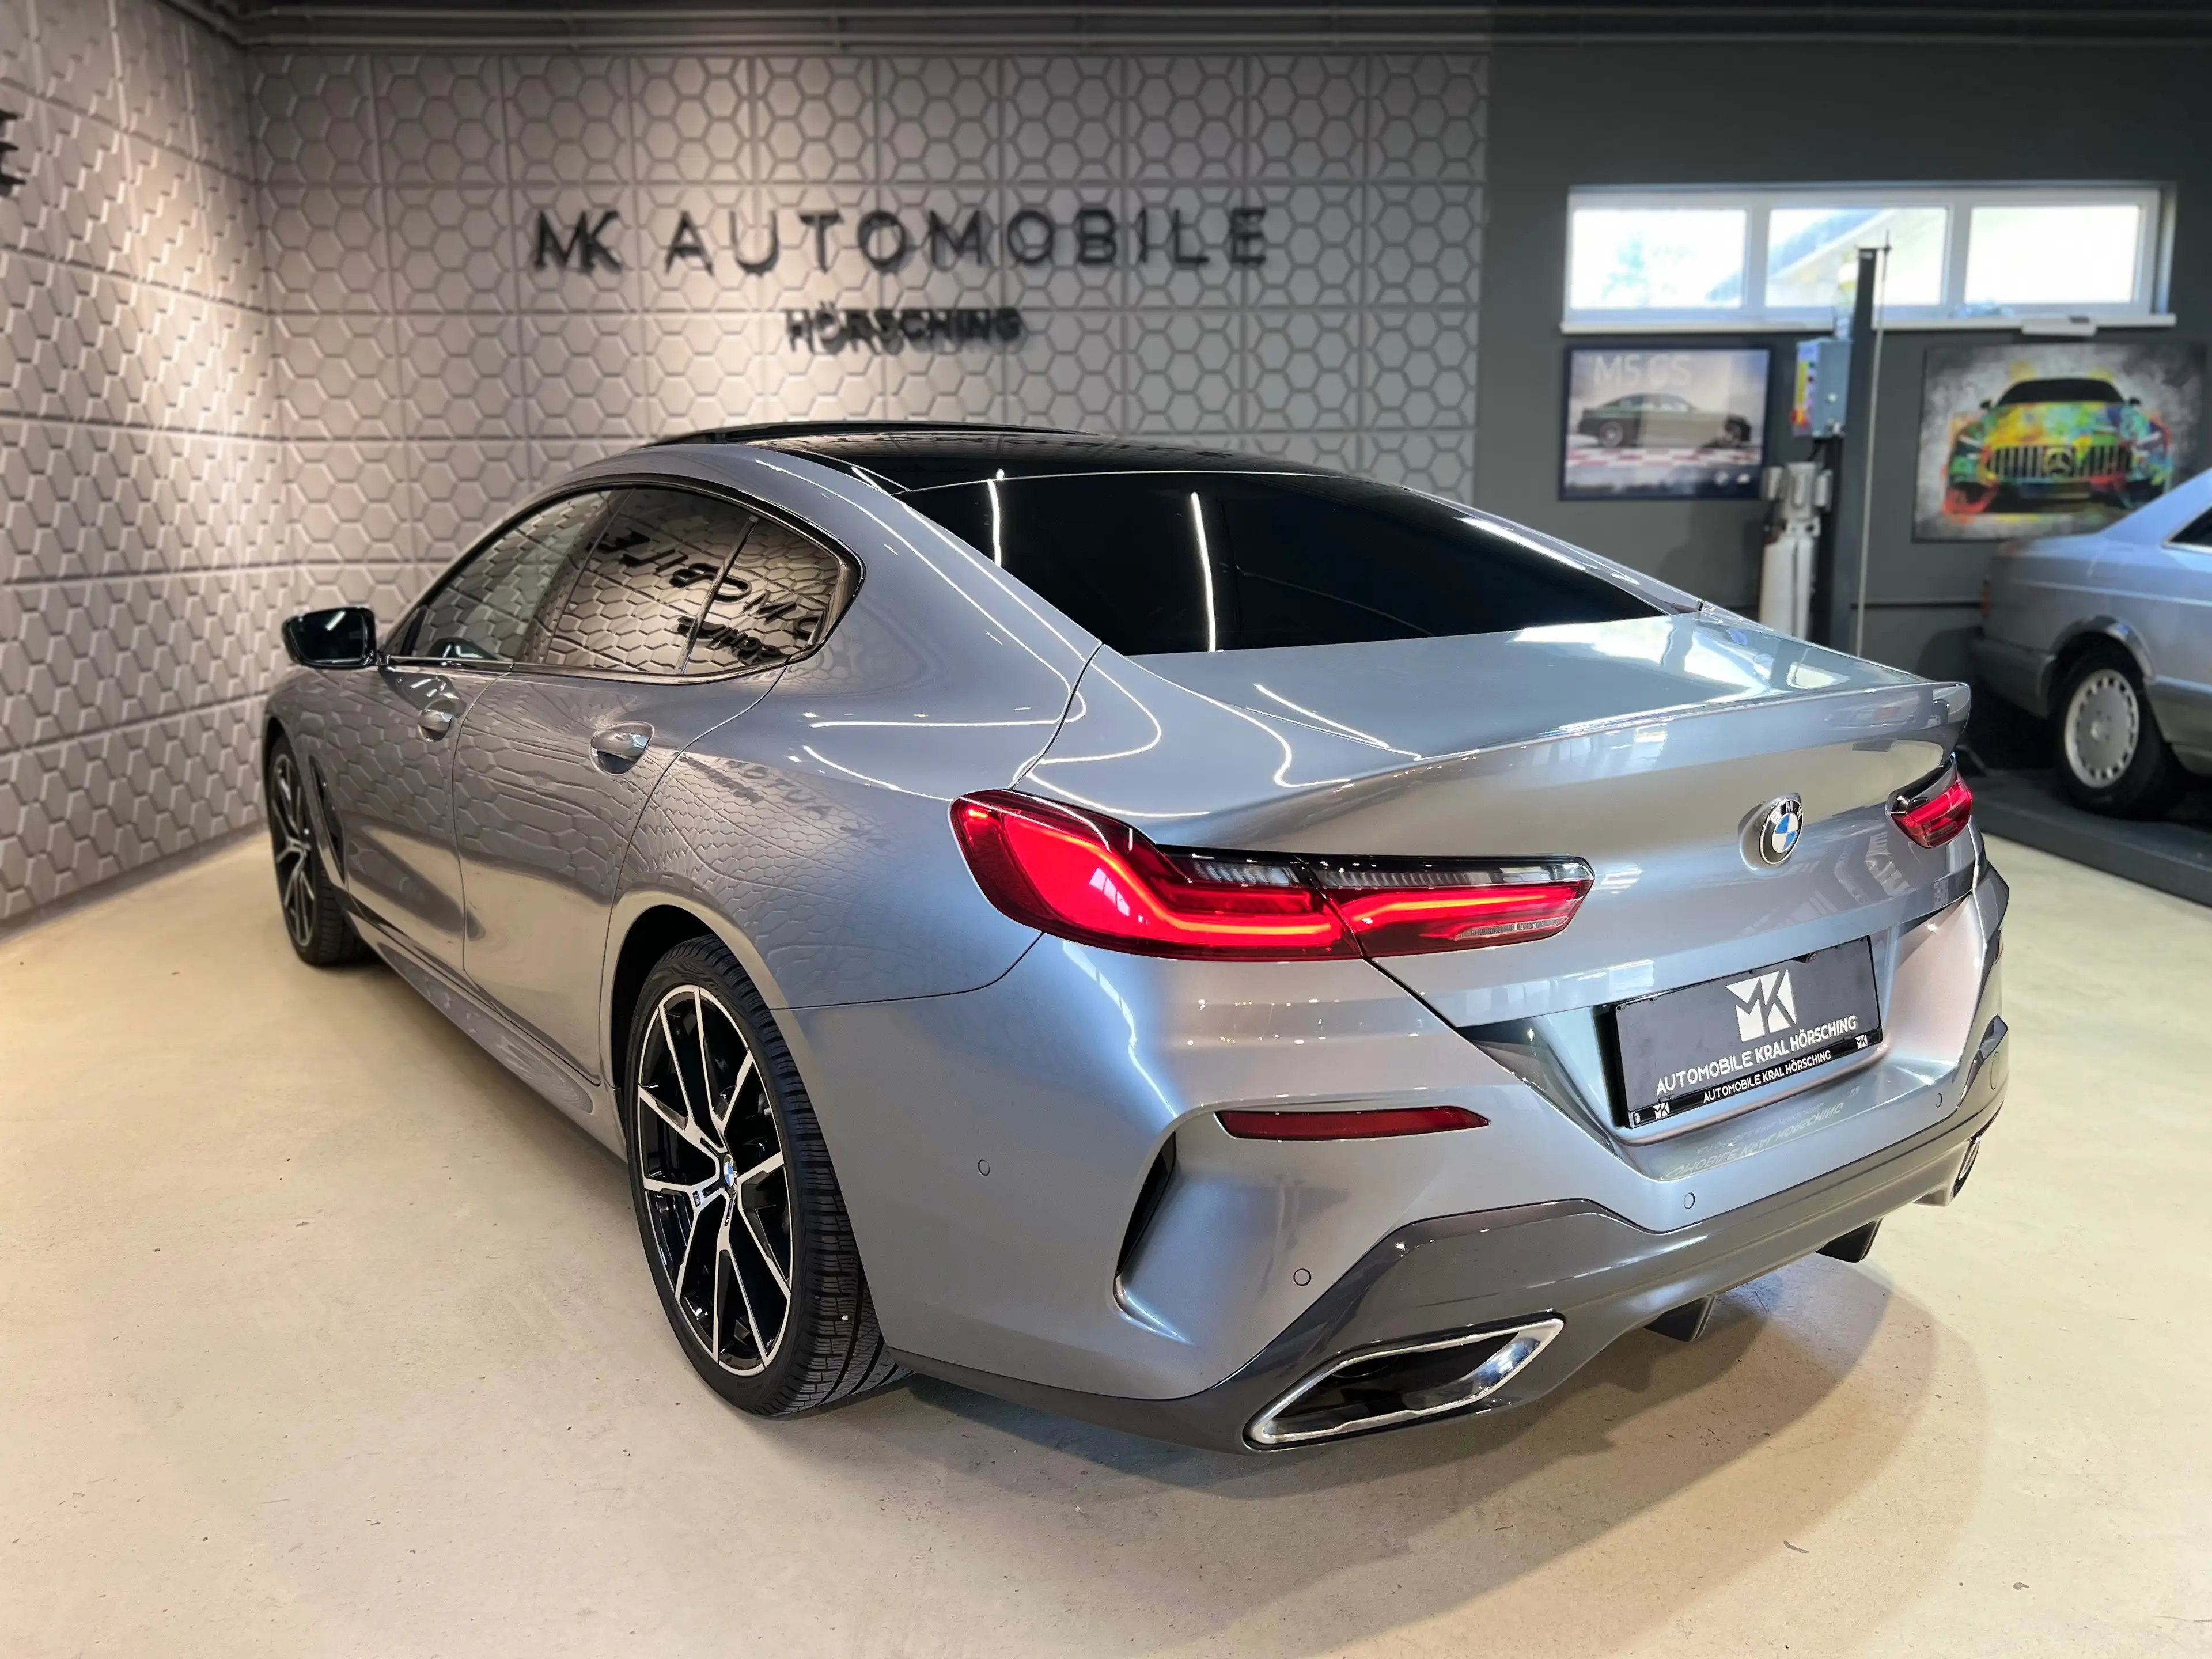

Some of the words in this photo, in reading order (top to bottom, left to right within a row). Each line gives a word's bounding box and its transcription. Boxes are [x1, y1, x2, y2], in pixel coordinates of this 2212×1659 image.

[535, 209, 623, 274] MK
[665, 207, 1267, 276] AUTOMOBILE
[786, 301, 1022, 346] HÖRSCHING
[1771, 800, 1803, 825] BMW
[1725, 968, 1797, 1042] MK
[1656, 1050, 1753, 1096] AUTOMOBILE
[1754, 1039, 1789, 1064] KRAL
[1789, 1014, 1857, 1052] HÖRSCHING
[1703, 1073, 1761, 1103] AUTOMOBILE
[1762, 1067, 1785, 1083] KRAL
[1785, 1050, 1832, 1075] HÖRSCHING
[1652, 1101, 1670, 1119] MK
